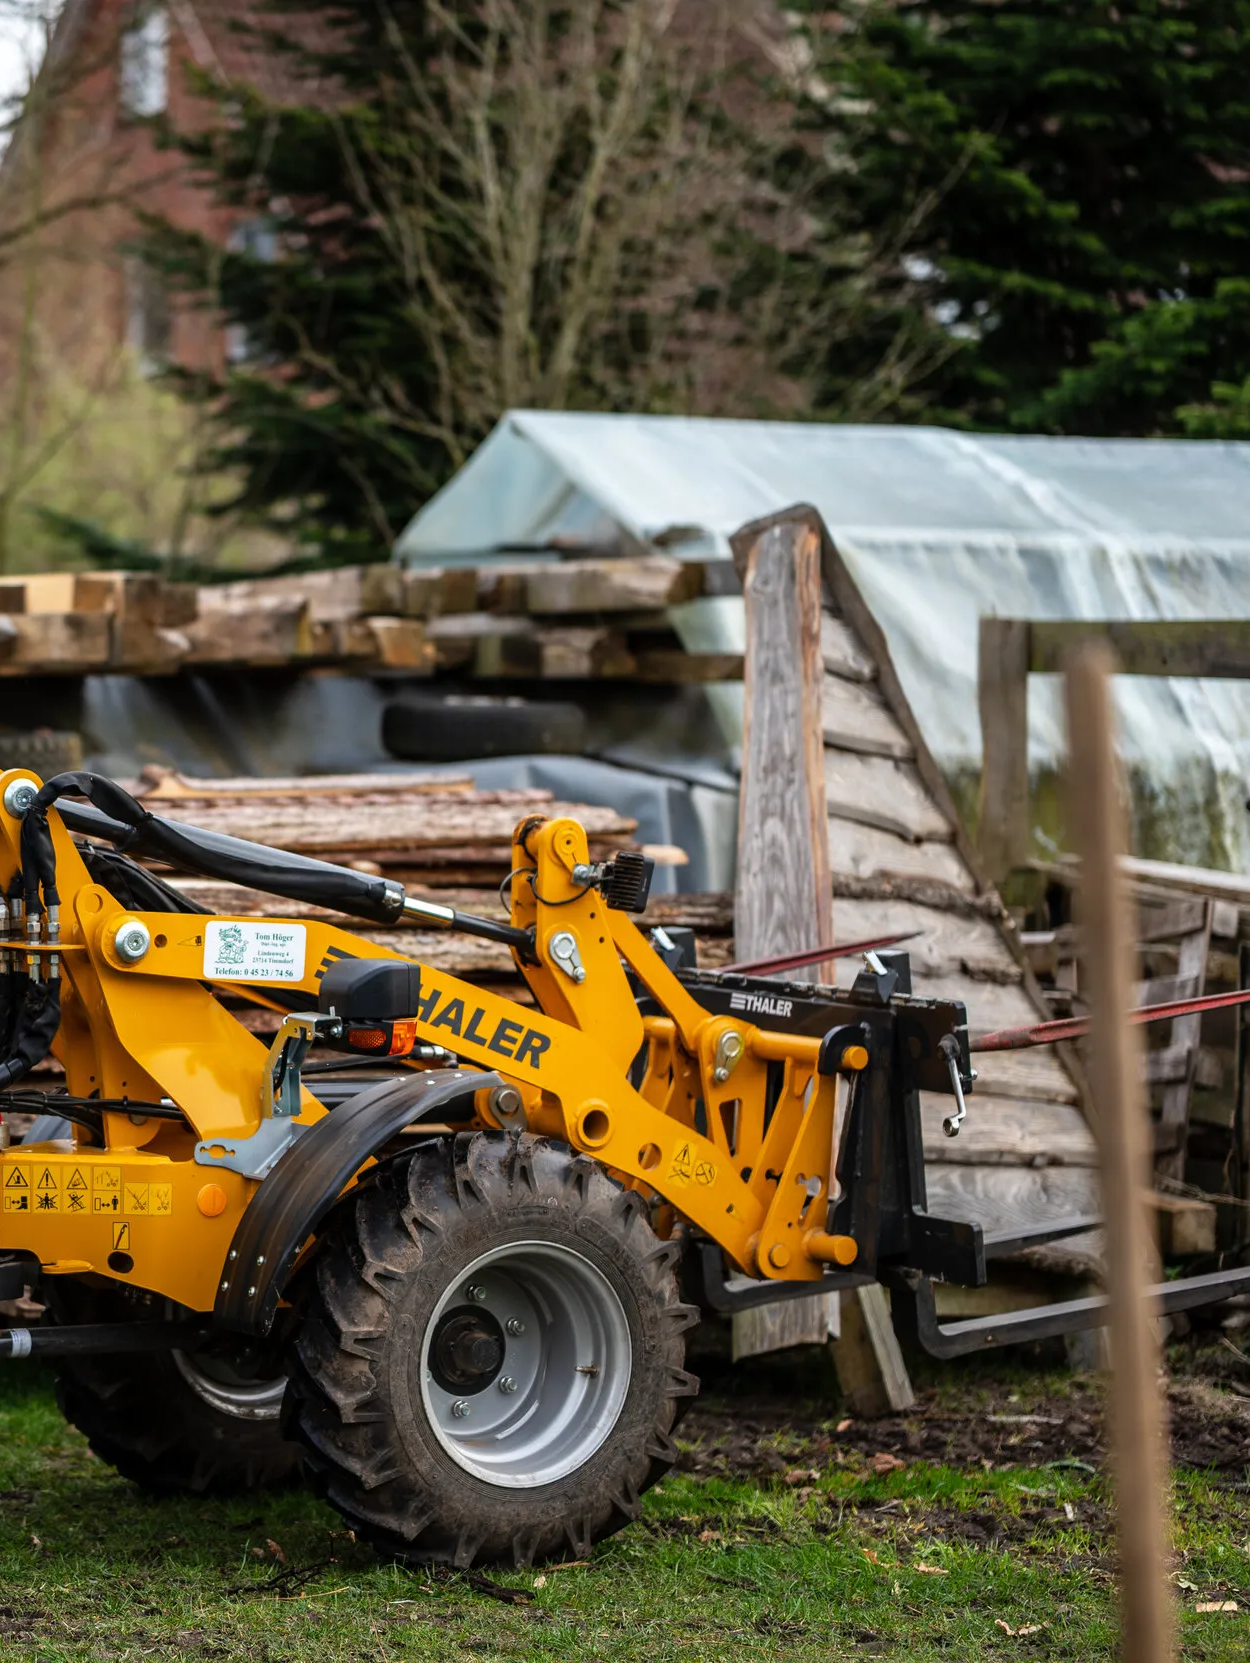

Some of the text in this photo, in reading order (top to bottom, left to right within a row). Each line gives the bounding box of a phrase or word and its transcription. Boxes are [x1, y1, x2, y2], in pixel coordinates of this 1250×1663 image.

[255, 932, 294, 942] Tom Höger
[214, 967, 242, 976] Telefon:
[746, 995, 793, 1018] THALER
[416, 984, 551, 1070] HALER
